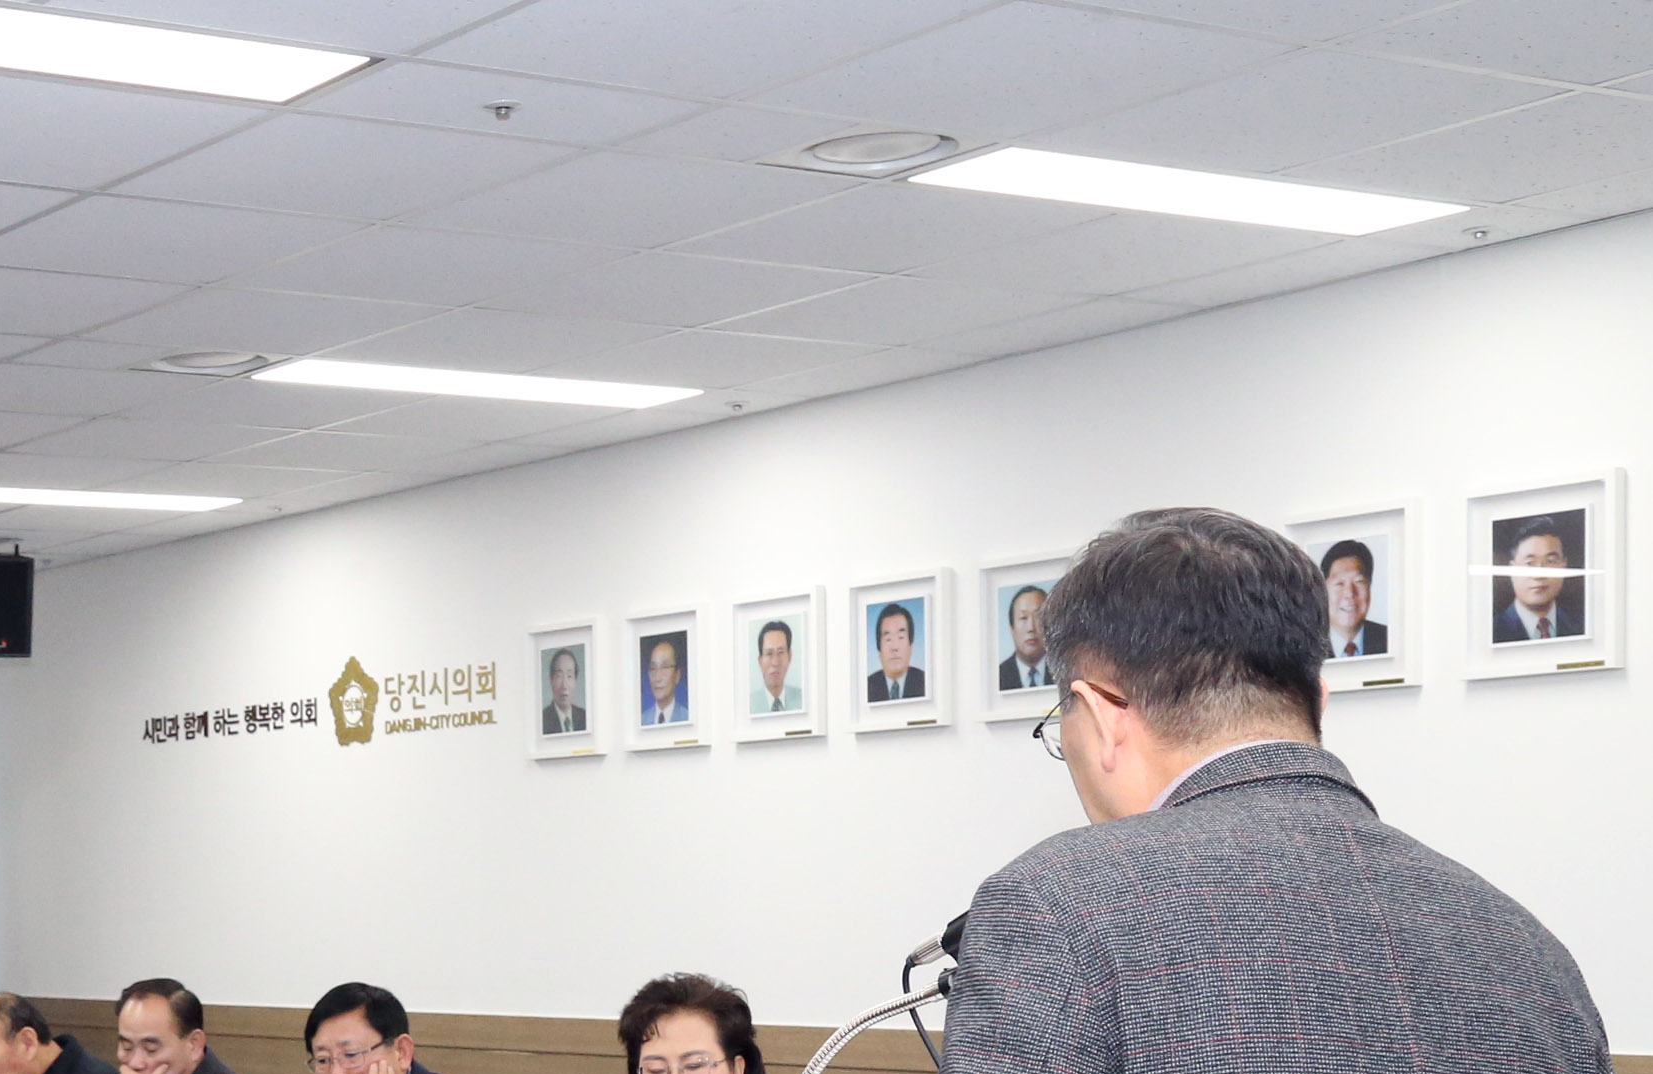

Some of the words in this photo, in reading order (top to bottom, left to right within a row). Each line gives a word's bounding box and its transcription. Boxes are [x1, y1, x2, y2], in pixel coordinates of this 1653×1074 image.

[384, 661, 496, 712] 당진시의회
[143, 714, 180, 744] 시민과
[183, 711, 209, 740] 함께
[213, 708, 240, 736] 하는
[244, 701, 286, 734] 행복한
[290, 697, 318, 727] 의회
[451, 709, 498, 728] COUNCIL
